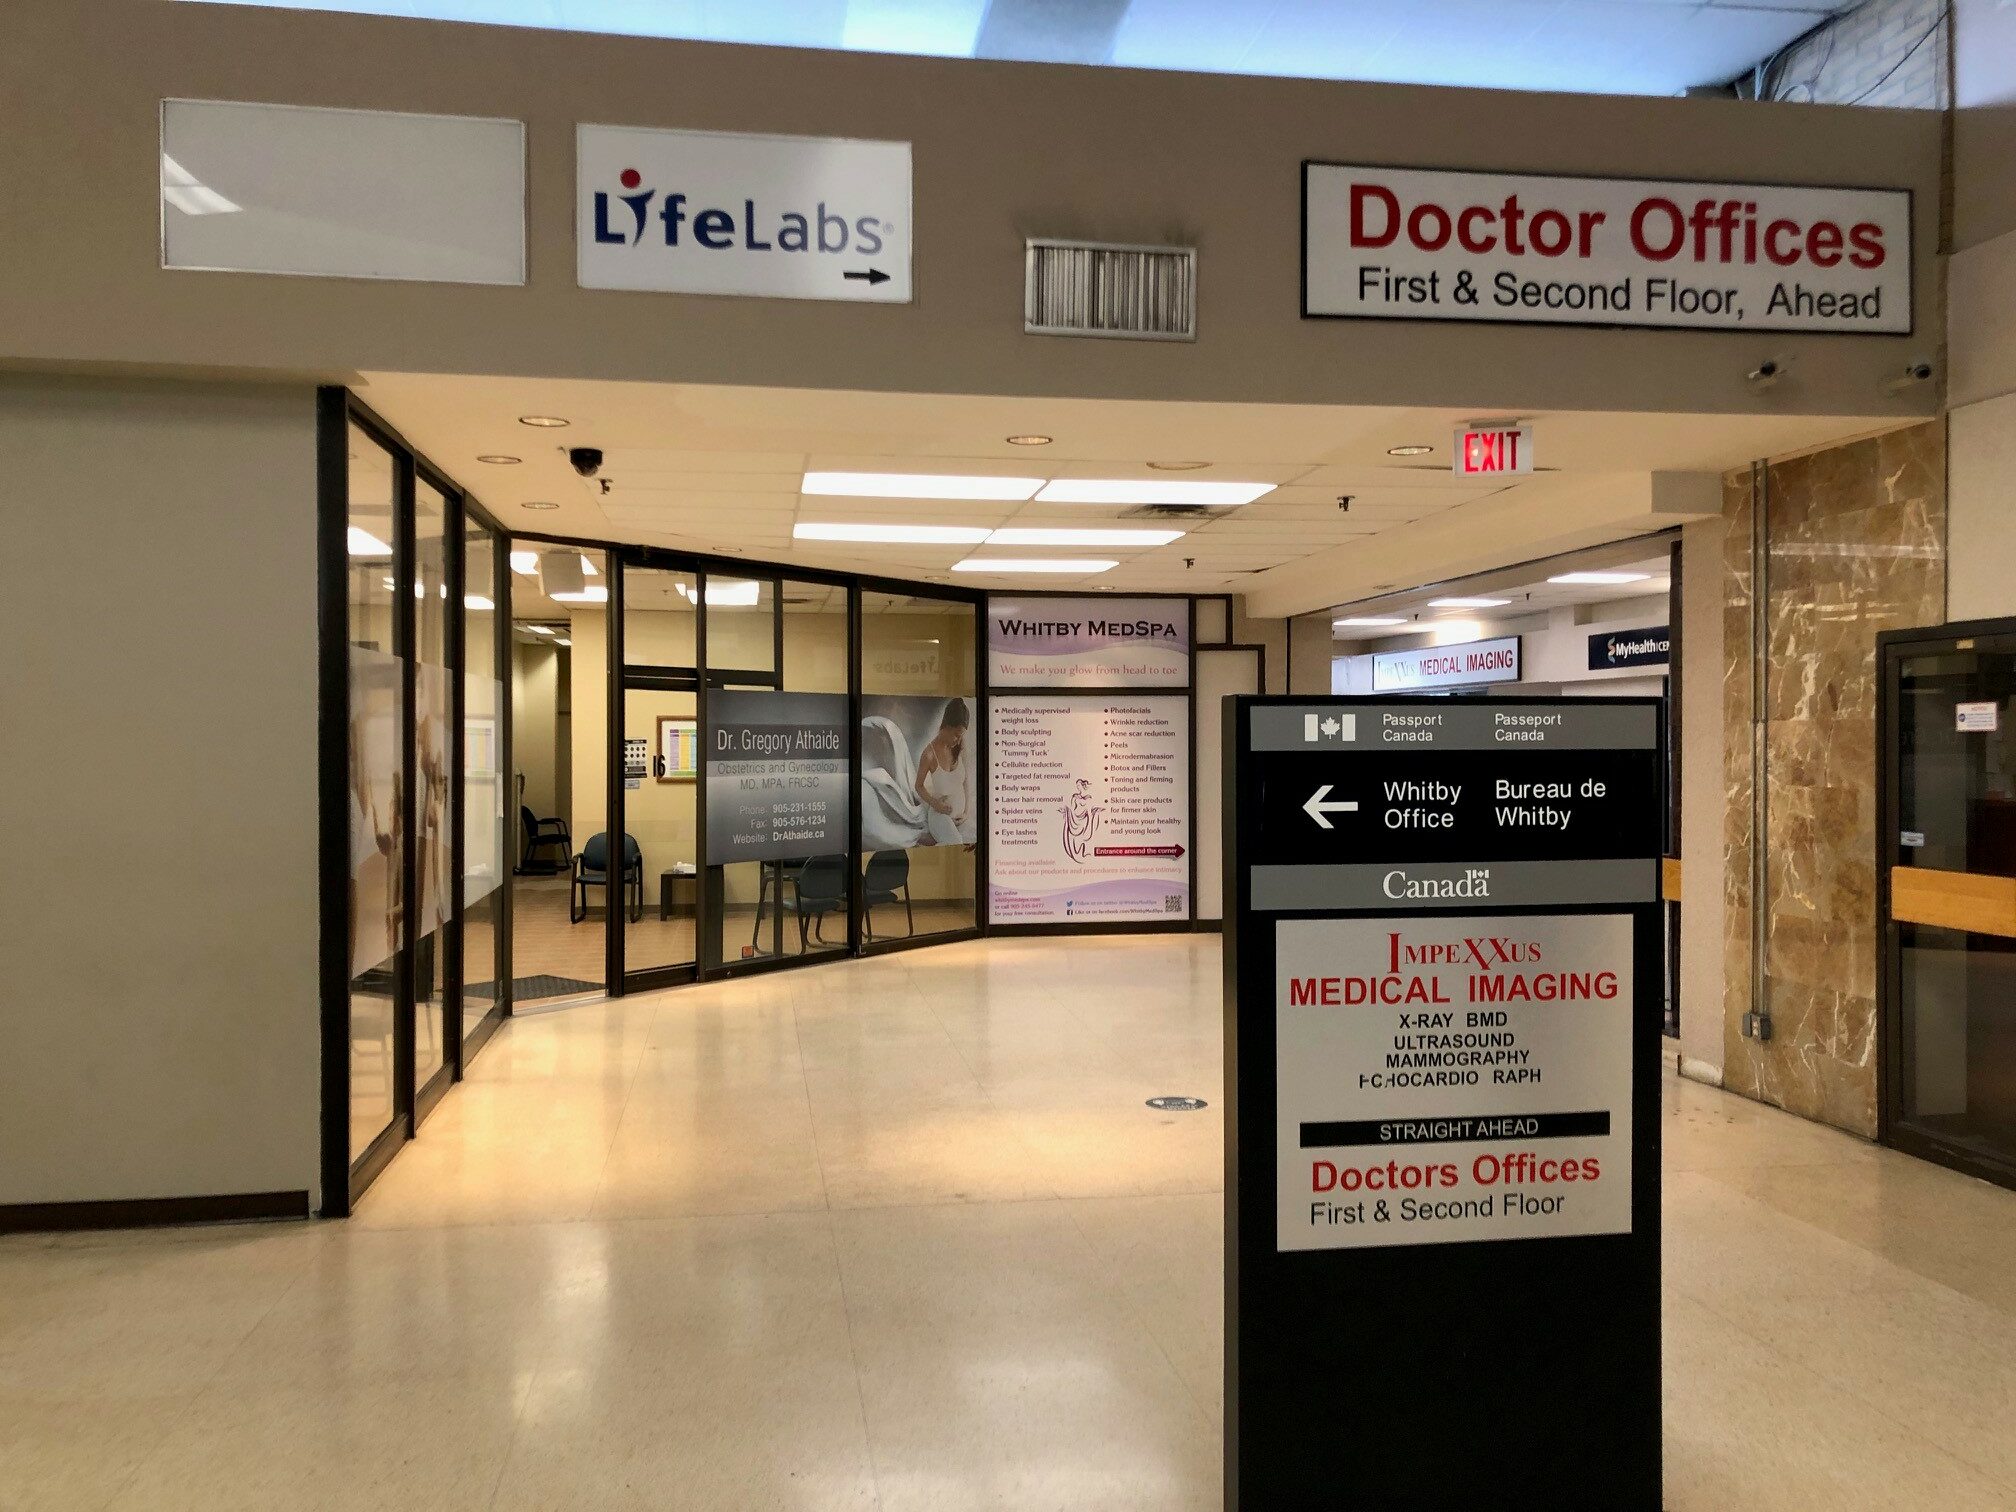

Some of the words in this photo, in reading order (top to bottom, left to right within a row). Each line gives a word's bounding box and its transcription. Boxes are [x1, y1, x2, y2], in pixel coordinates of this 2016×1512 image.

[594, 168, 883, 255] LifeLabs
[1349, 184, 1606, 258] Doctor
[1630, 198, 1886, 269] Offices
[1358, 267, 1440, 304] First
[1454, 271, 1479, 305] &
[1493, 272, 1631, 311] Second
[1646, 280, 1743, 320] Floor,
[1767, 284, 1881, 319] Ahead
[1464, 432, 1522, 473] EXIT
[998, 620, 1081, 636] WHITBY
[1001, 665, 1015, 674] We
[1019, 664, 1045, 674] make
[1049, 667, 1066, 677] you
[1069, 665, 1092, 677] glow
[1096, 664, 1119, 674] from
[1123, 664, 1146, 674] head
[1150, 666, 1159, 674] to
[1163, 666, 1177, 674] toe
[1419, 656, 1462, 675] MEDICAL
[1466, 649, 1513, 672] IMAGING
[1001, 707, 1033, 715] Medically
[1035, 707, 1071, 715] supervised
[1382, 713, 1443, 727] Passport
[1495, 713, 1562, 727] Passeport
[1001, 728, 1019, 736] Body
[1382, 729, 1433, 742] Canada
[1495, 729, 1544, 742] Canada
[717, 729, 737, 750] Dr.
[742, 729, 792, 755] Gregory
[795, 730, 840, 750] Athaide
[653, 754, 666, 778] 16
[717, 762, 766, 775] Obstetrics
[769, 762, 786, 773] and
[788, 761, 839, 774] Gynecology
[789, 777, 820, 788] FRCSC
[1149, 776, 1173, 784] firming
[1496, 779, 1572, 799] Bureau
[1581, 778, 1607, 798] de
[1384, 781, 1462, 805] Whitby
[772, 815, 826, 827] 905-576-1234
[1384, 808, 1454, 828] Office
[1495, 806, 1572, 830] Whitby
[733, 833, 768, 844] Website:
[773, 830, 825, 842] DrAthaide.ca
[1040, 868, 1069, 876] products
[1382, 869, 1490, 899] Canada
[1290, 976, 1451, 1006] MEDICAL
[1468, 971, 1619, 1002] IMAGING
[1399, 1013, 1453, 1029] X-RAY
[1467, 1012, 1508, 1027] BMD
[1394, 1033, 1515, 1051] ULTRASOUND
[1386, 1050, 1530, 1069] MAMMOGRAPHY
[1379, 1120, 1472, 1141] STRAIGHT
[1476, 1118, 1539, 1137] AHEAD
[1312, 1159, 1459, 1193] Doctors
[1472, 1152, 1601, 1186] Offices
[1310, 1199, 1365, 1226] First
[1373, 1199, 1392, 1222] &
[1400, 1195, 1494, 1222] Second
[1503, 1193, 1565, 1217] Floor
